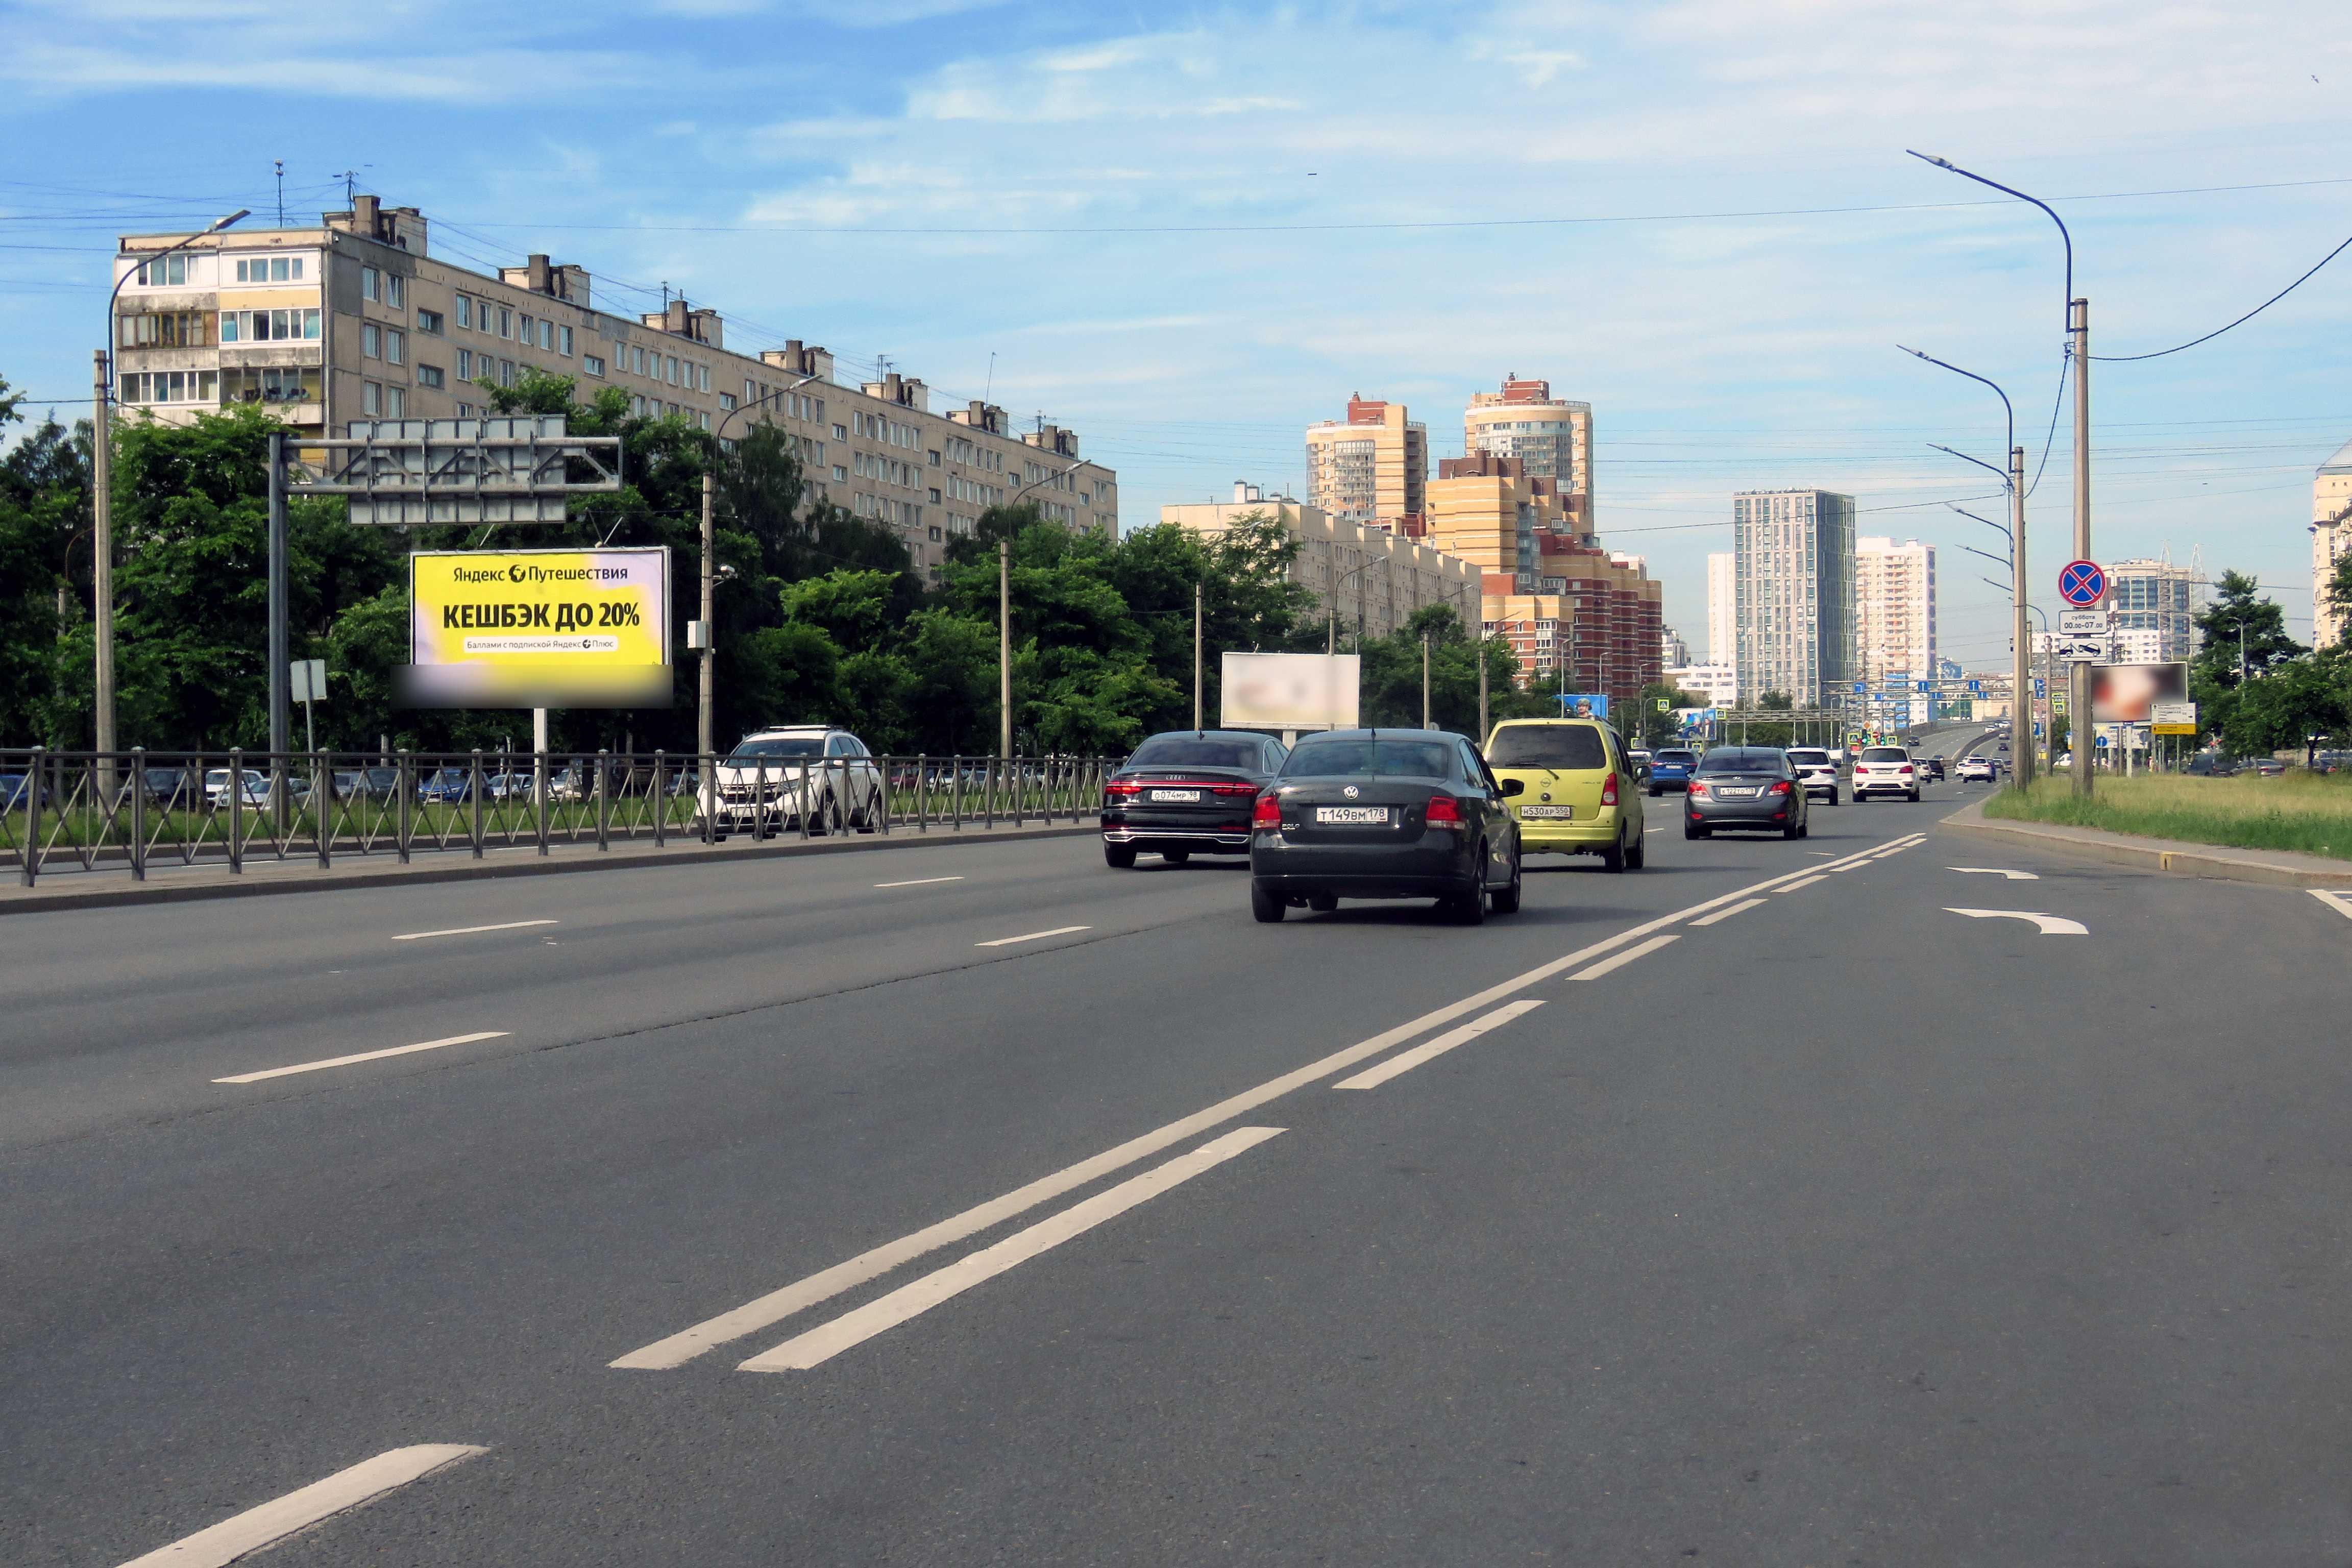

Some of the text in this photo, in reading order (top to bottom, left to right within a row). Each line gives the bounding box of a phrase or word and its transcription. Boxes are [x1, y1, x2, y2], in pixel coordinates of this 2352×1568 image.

[454, 566, 628, 583] Яндекс Путешествия
[444, 602, 640, 632] КЕШБЭК ДО 20%
[509, 641, 551, 649] подпиской
